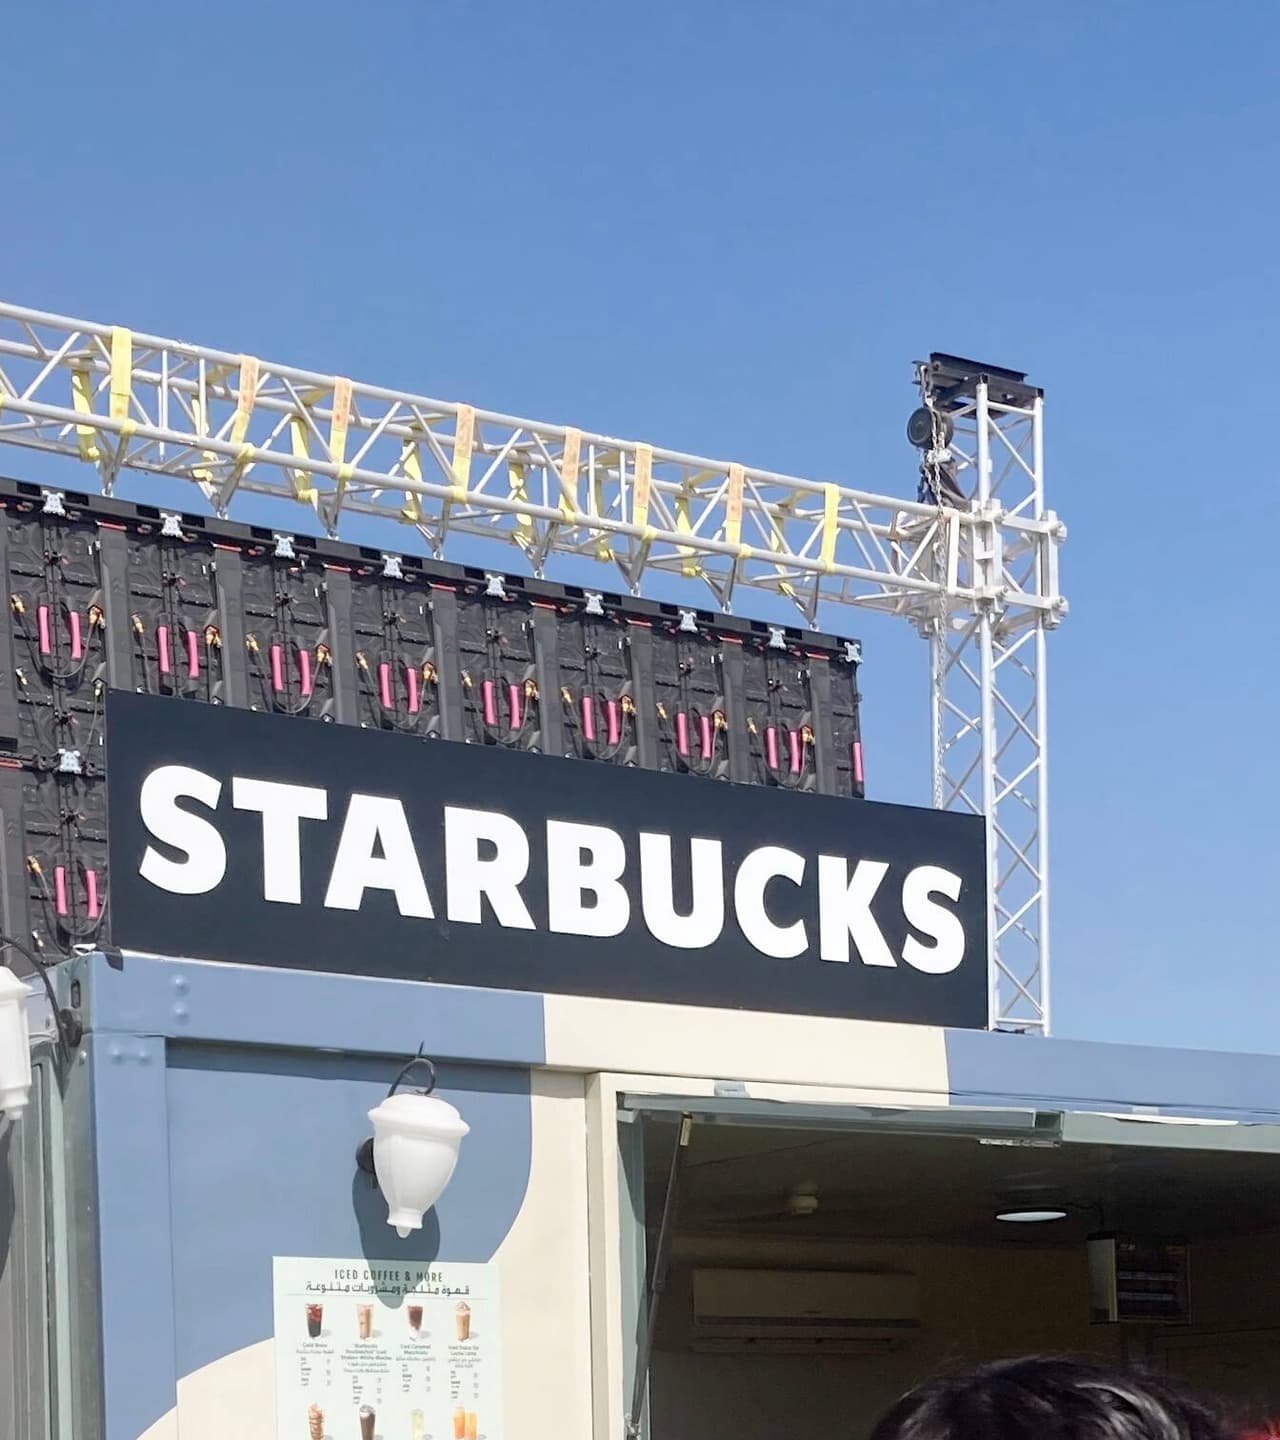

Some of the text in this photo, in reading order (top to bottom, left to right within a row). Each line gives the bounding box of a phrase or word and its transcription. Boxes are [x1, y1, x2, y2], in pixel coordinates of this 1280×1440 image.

[138, 765, 966, 975] STARBUCKS
[334, 1269, 358, 1281] ICED
[363, 1270, 400, 1282] COFFEE
[416, 1272, 443, 1283] MORE
